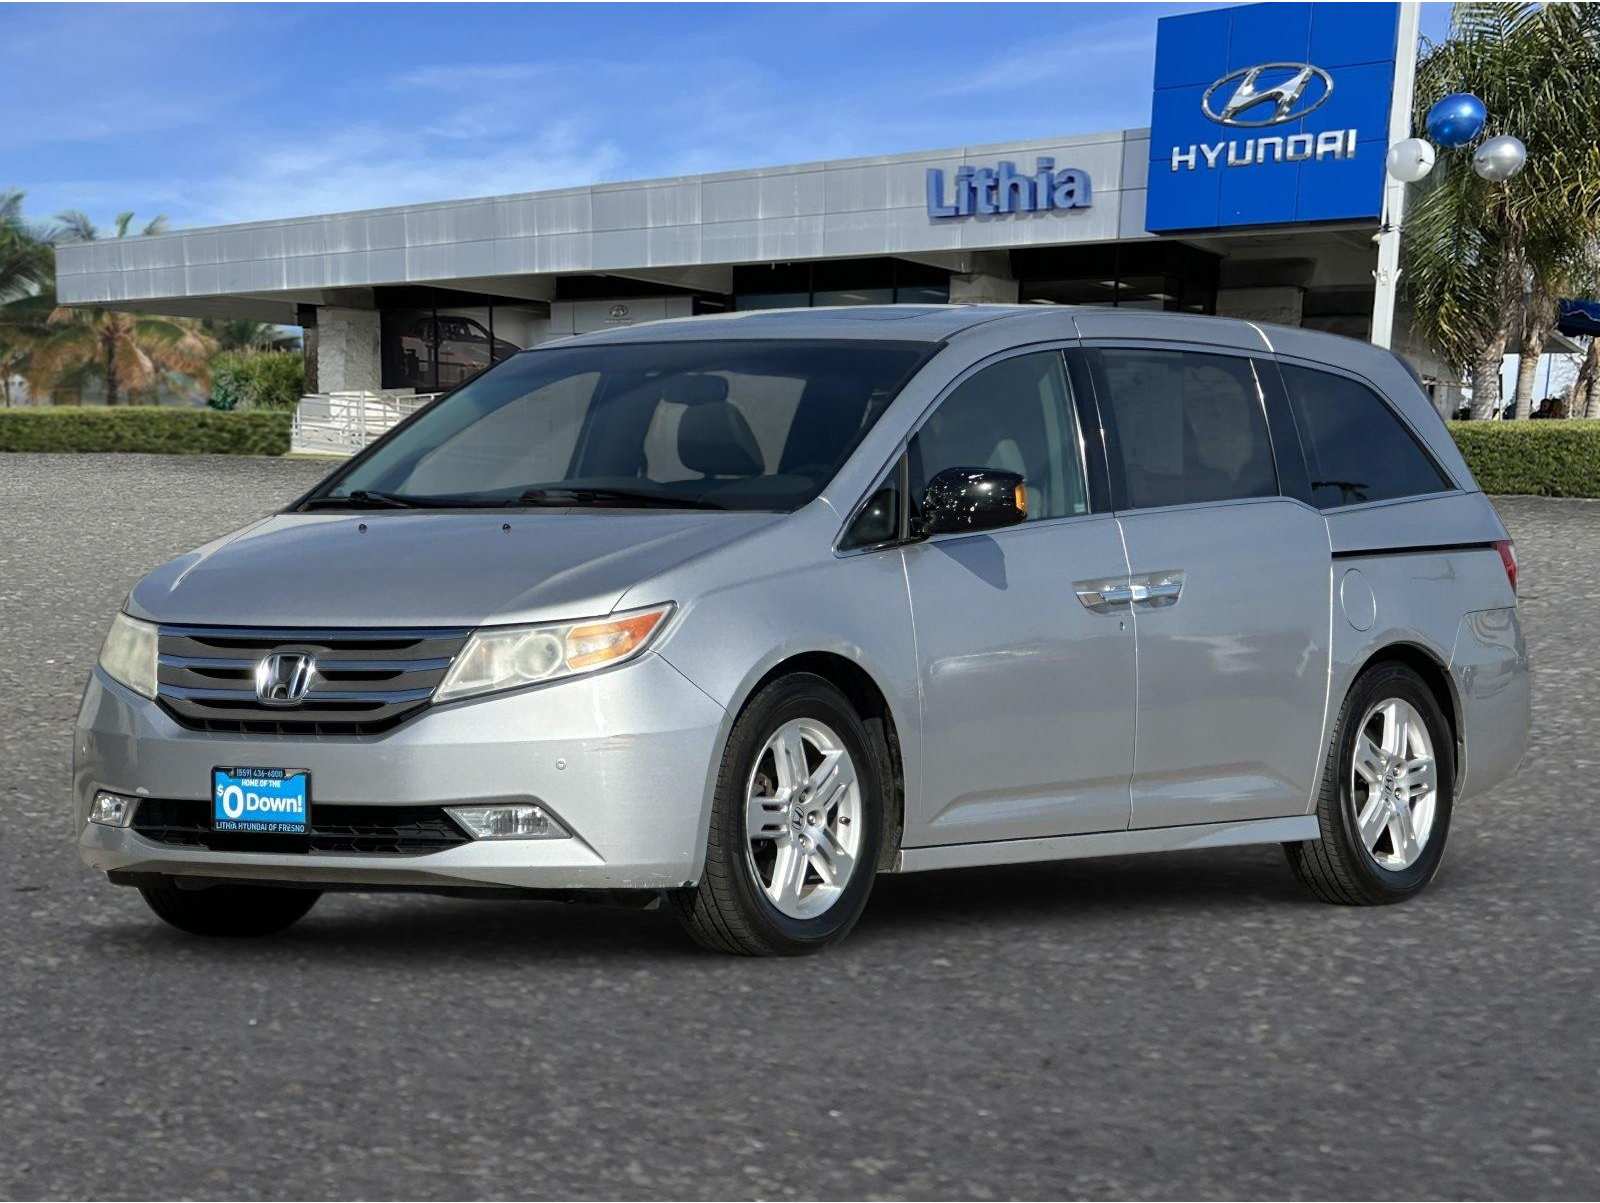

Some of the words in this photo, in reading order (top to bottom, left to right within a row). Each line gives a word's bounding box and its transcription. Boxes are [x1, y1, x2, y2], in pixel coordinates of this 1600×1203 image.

[1171, 128, 1358, 172] HYUNDAI
[926, 156, 1093, 218] Lithia
[241, 779, 260, 787] HOME
[260, 779, 269, 787] OF
[269, 779, 281, 788] THE
[246, 792, 303, 813] Down!
[216, 821, 238, 830] LITHIA
[238, 822, 267, 831] HYUNDAI
[268, 823, 277, 831] OF
[278, 823, 305, 833] FRESNO
